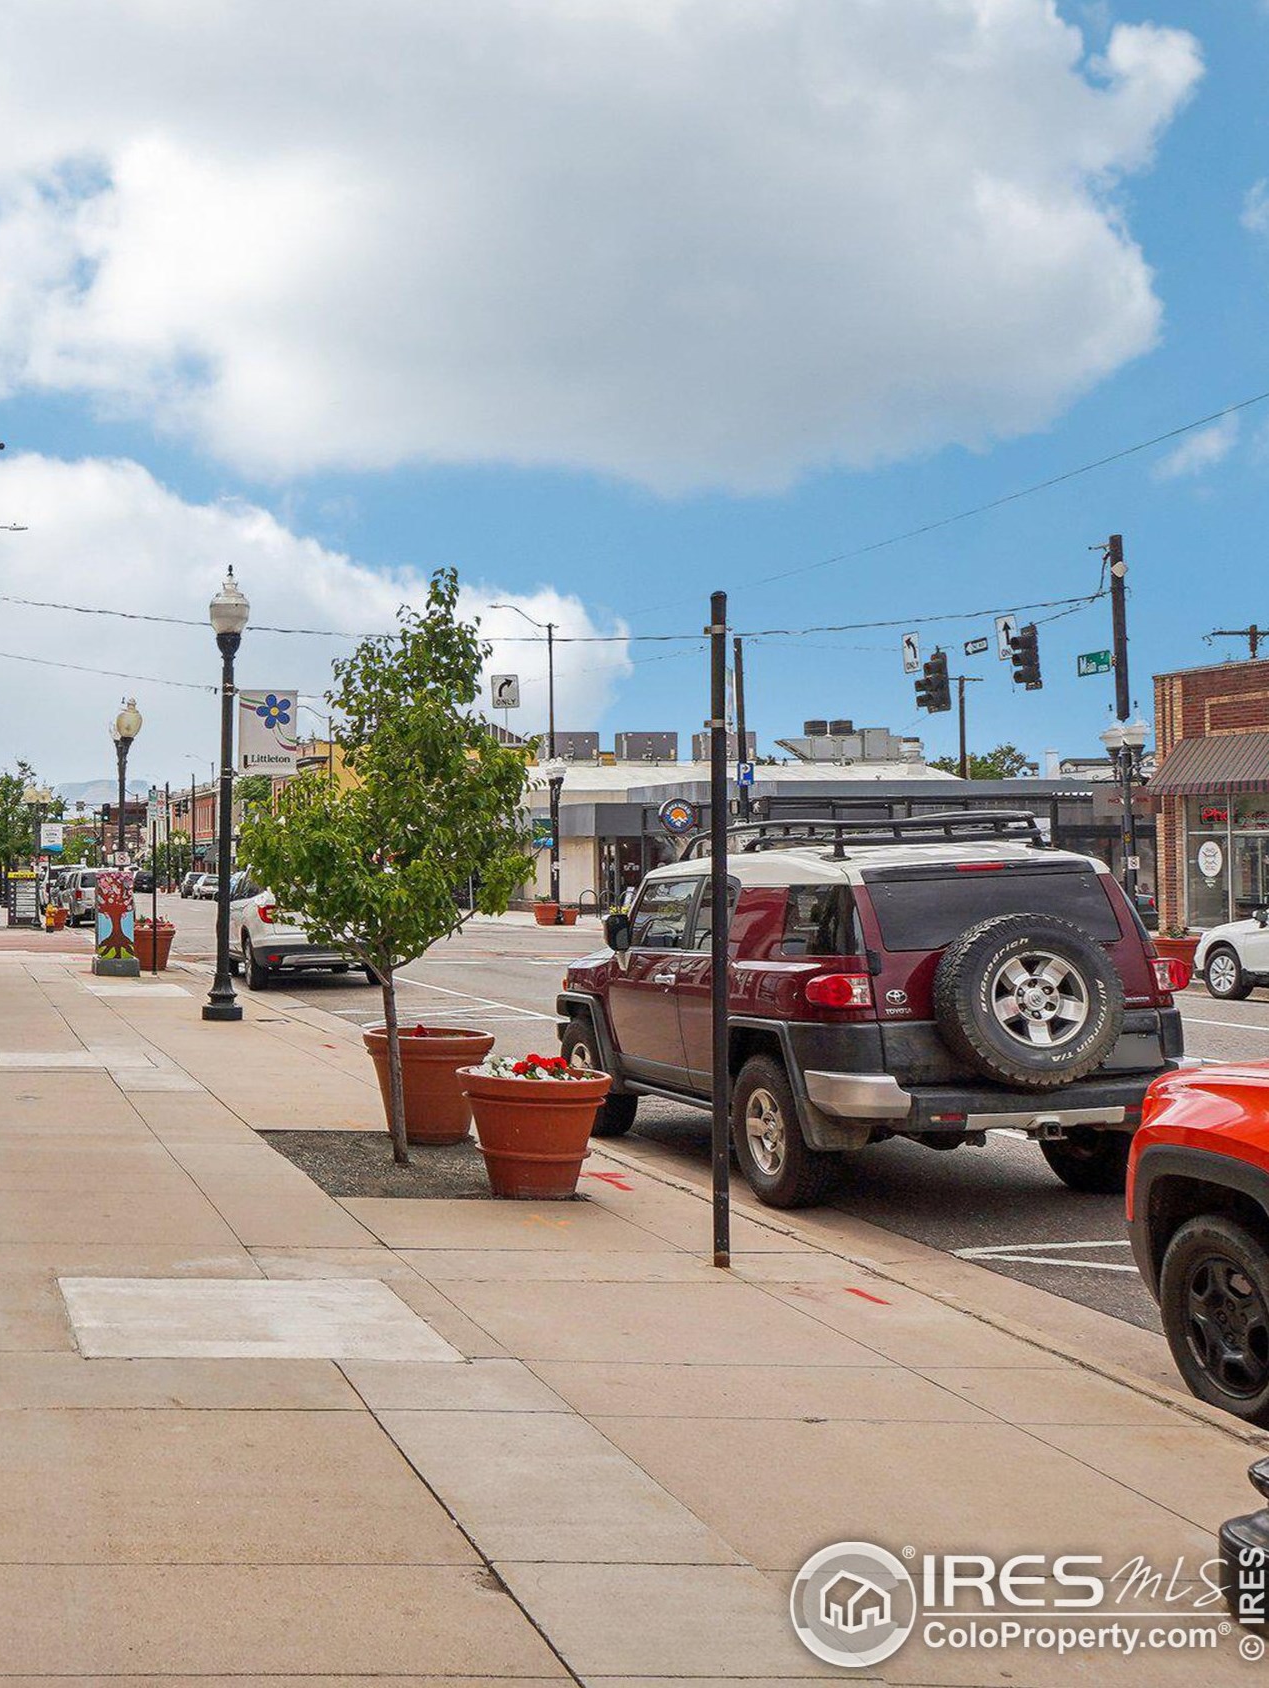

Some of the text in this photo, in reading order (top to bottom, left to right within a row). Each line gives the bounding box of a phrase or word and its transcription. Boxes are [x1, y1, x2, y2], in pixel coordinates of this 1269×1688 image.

[496, 698, 516, 706] ONLY
[251, 754, 291, 763] Littleton
[885, 1007, 912, 1015] TOYOTA
